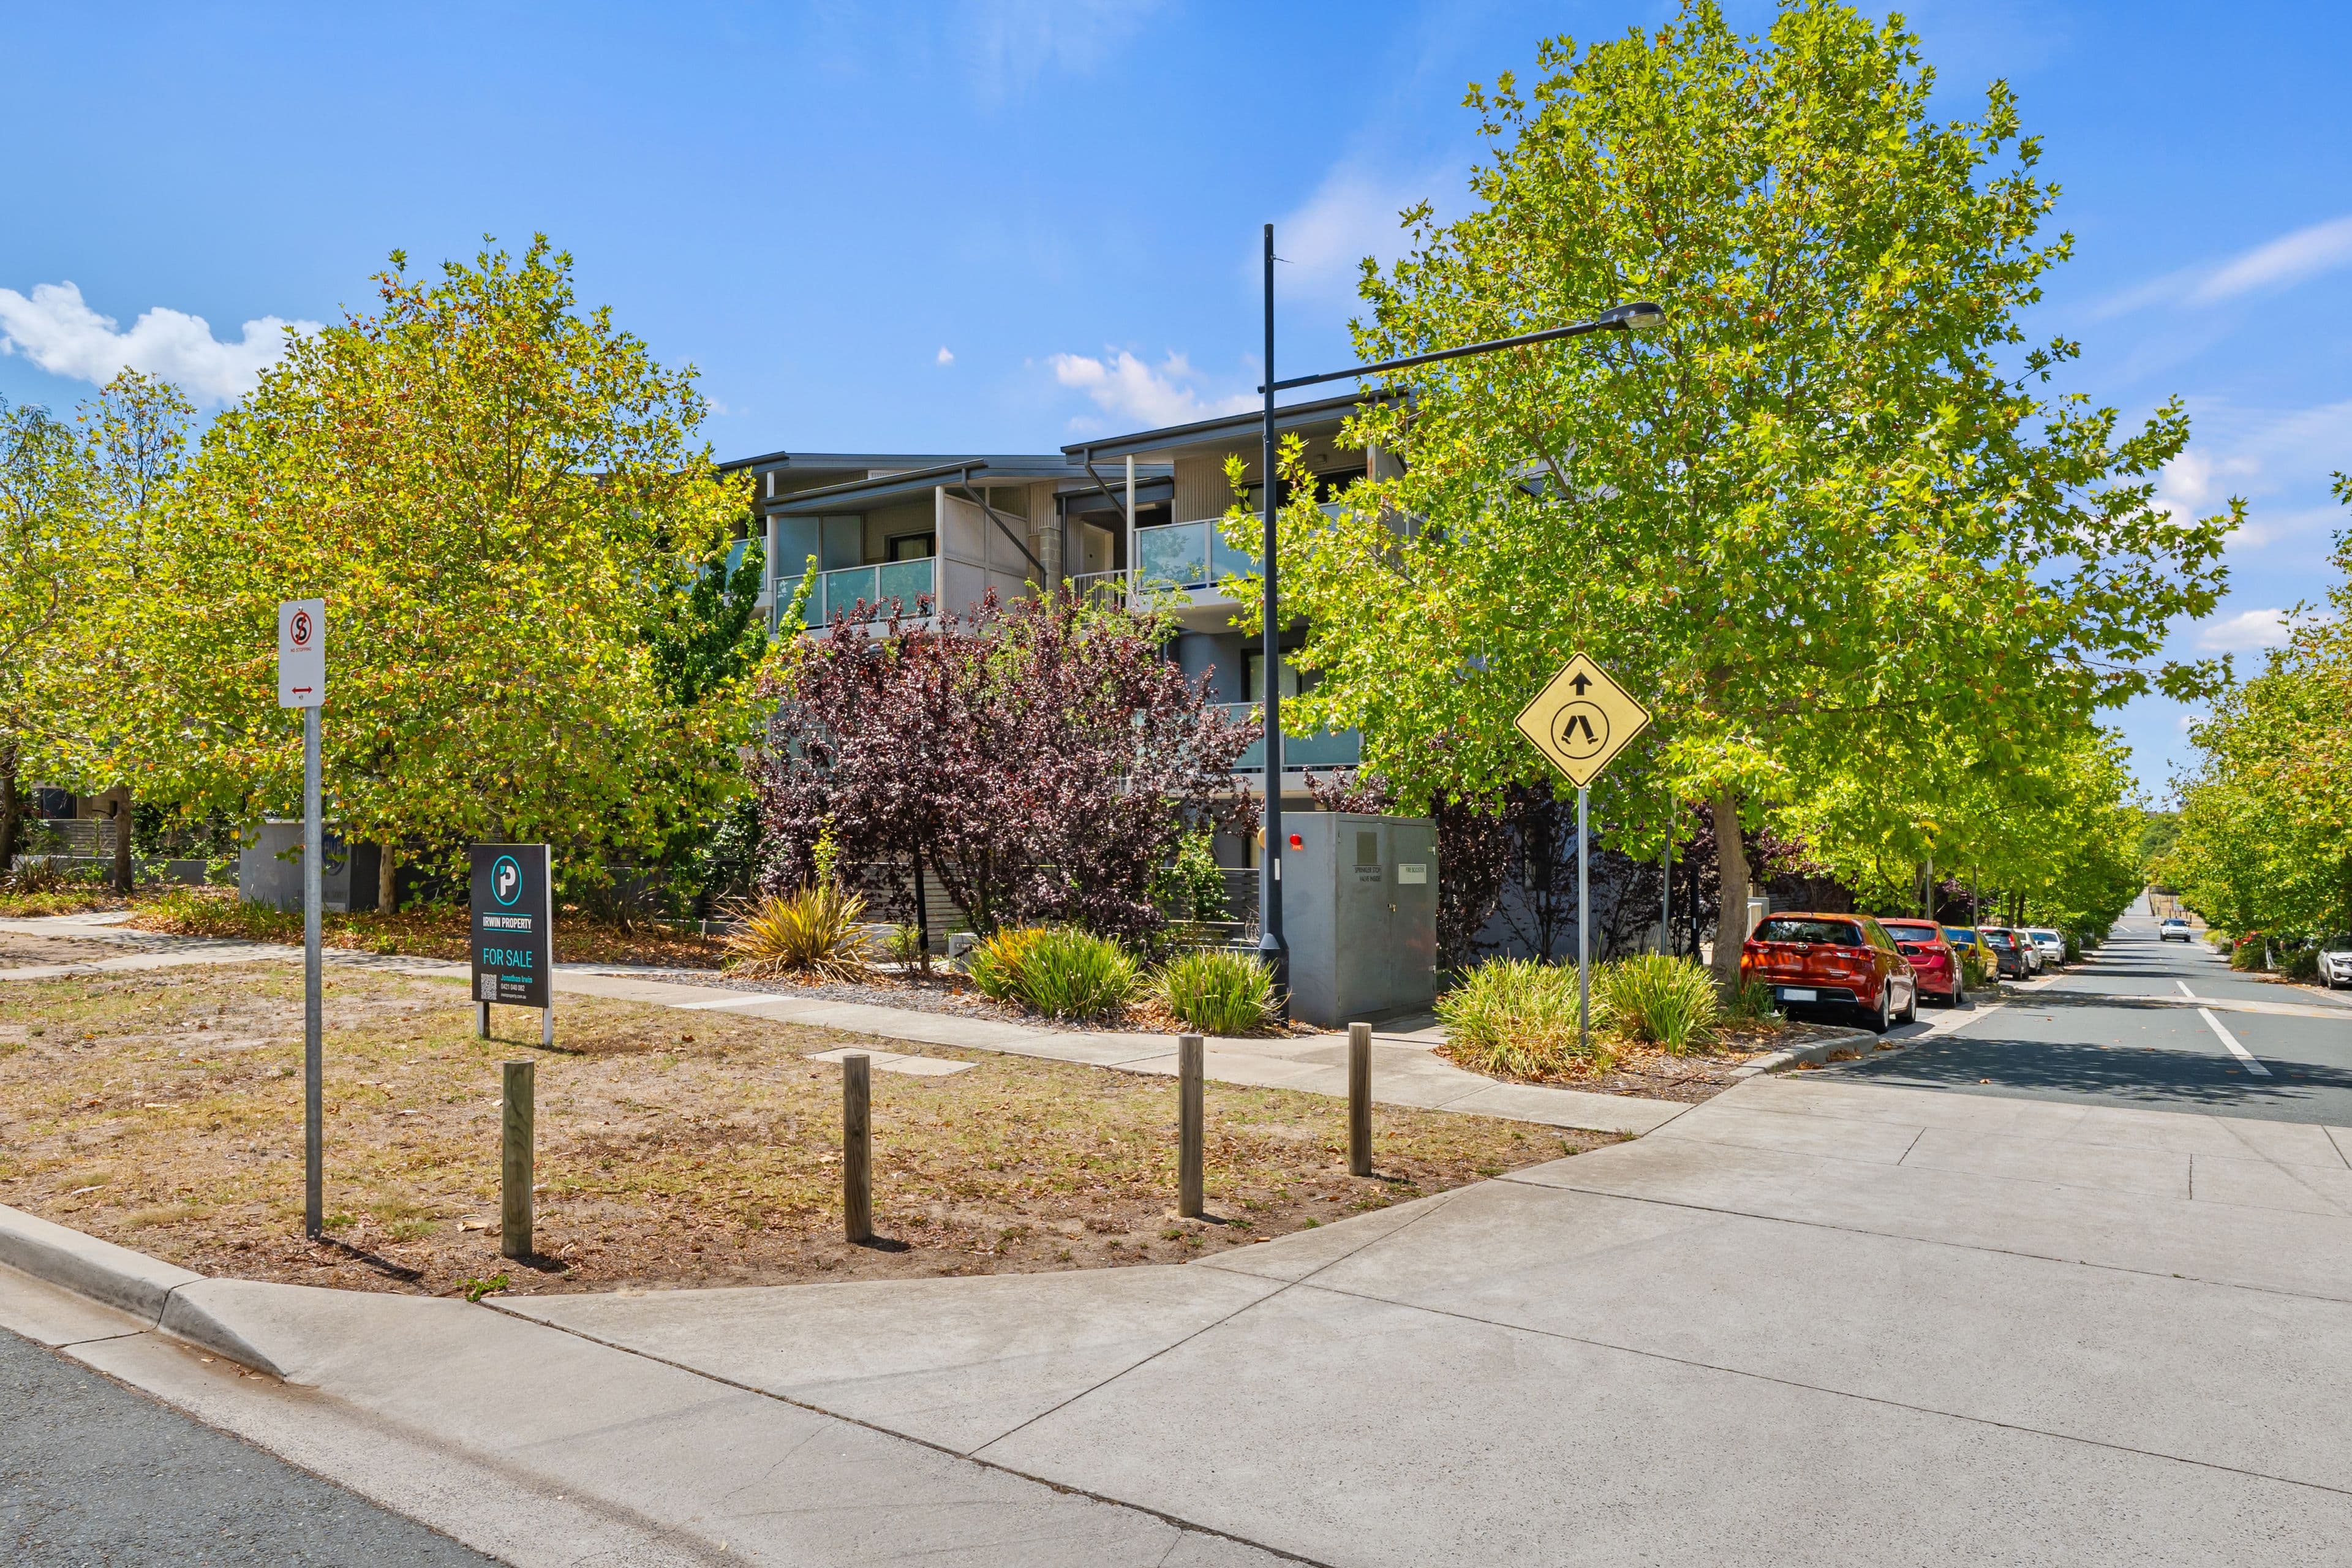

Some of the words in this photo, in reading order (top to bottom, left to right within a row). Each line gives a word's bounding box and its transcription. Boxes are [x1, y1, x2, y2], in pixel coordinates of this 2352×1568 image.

[483, 916, 500, 927] IRWIN
[502, 917, 532, 929] PROPERTY
[483, 948, 503, 965] FOR
[506, 949, 532, 968] SALE
[501, 974, 521, 982] Jonathan
